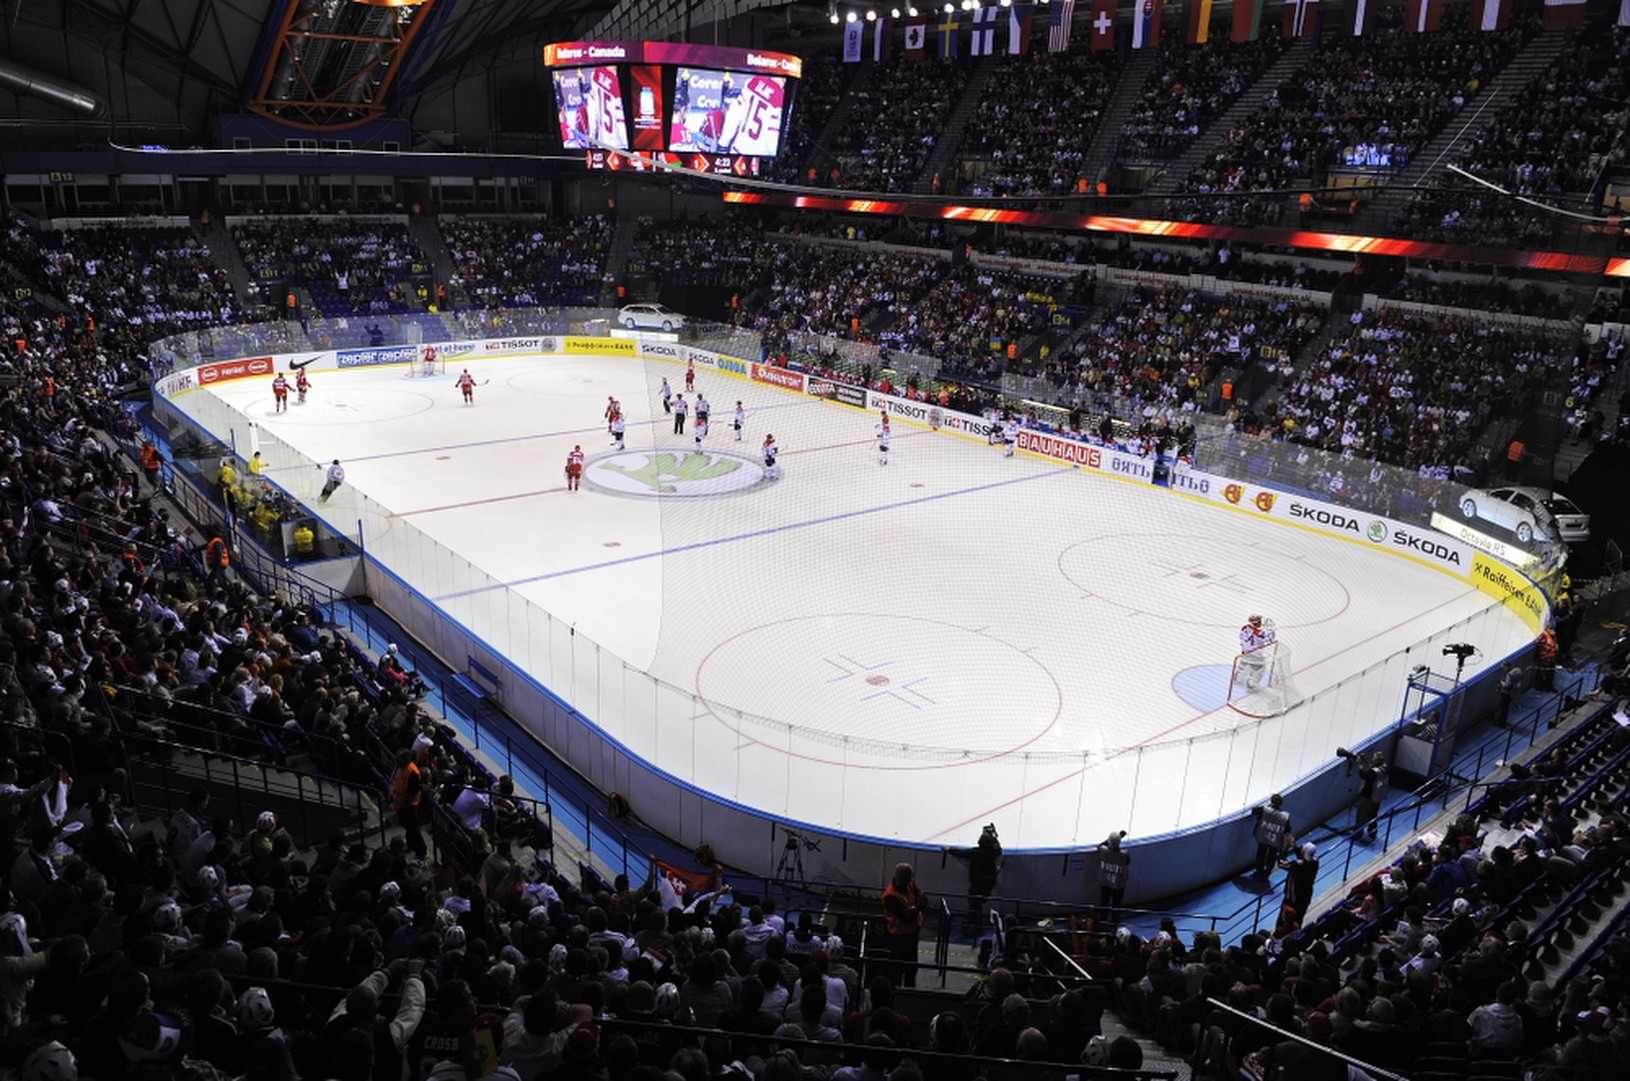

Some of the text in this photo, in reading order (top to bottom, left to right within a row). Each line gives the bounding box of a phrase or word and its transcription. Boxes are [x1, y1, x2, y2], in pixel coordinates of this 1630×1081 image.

[588, 46, 626, 58] Canada
[500, 339, 540, 349] TISSOT
[887, 400, 928, 420] TISSOT
[961, 420, 991, 436] TISS
[1017, 430, 1101, 468] BAUHAUS
[1289, 502, 1361, 533] ŠKODA
[1393, 530, 1461, 566] ŠKODA
[1459, 527, 1493, 552] Octavia
[1482, 566, 1527, 602] Raiffeisen
